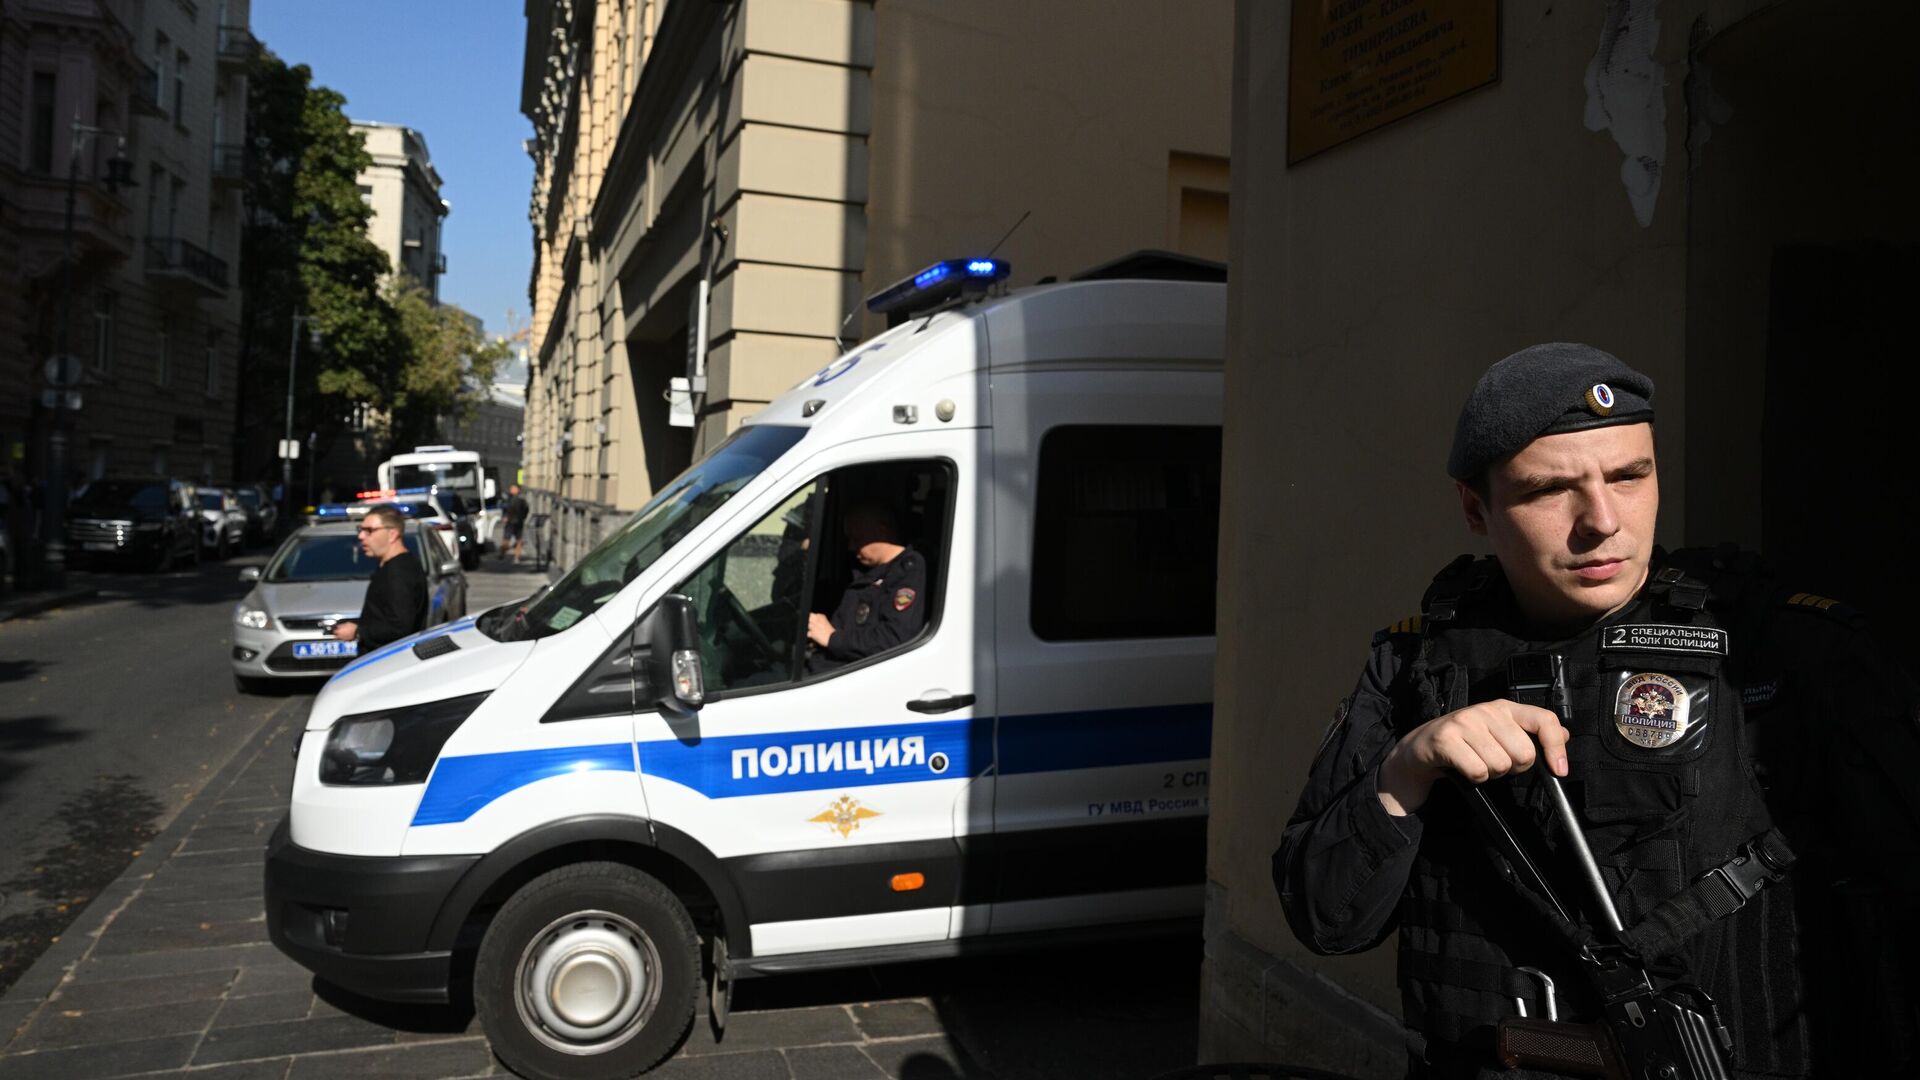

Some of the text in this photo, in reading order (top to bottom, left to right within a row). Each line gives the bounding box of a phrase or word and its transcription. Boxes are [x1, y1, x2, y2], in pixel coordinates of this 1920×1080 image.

[1612, 628, 1626, 644] 2
[1631, 628, 1719, 641] СПЕЦИАЛЬНЫЙ
[1631, 636, 1719, 649] ПОЛК ПОЛИЦИИ
[1648, 675, 1683, 696] РОССИИ
[1624, 716, 1676, 729] ПОЛИЦИЯ
[731, 735, 926, 780] ПОЛИЦИЯ
[1163, 773, 1175, 788] 2
[1088, 803, 1104, 816] ГУ
[1110, 800, 1144, 815] МВД
[1149, 798, 1199, 811] России
